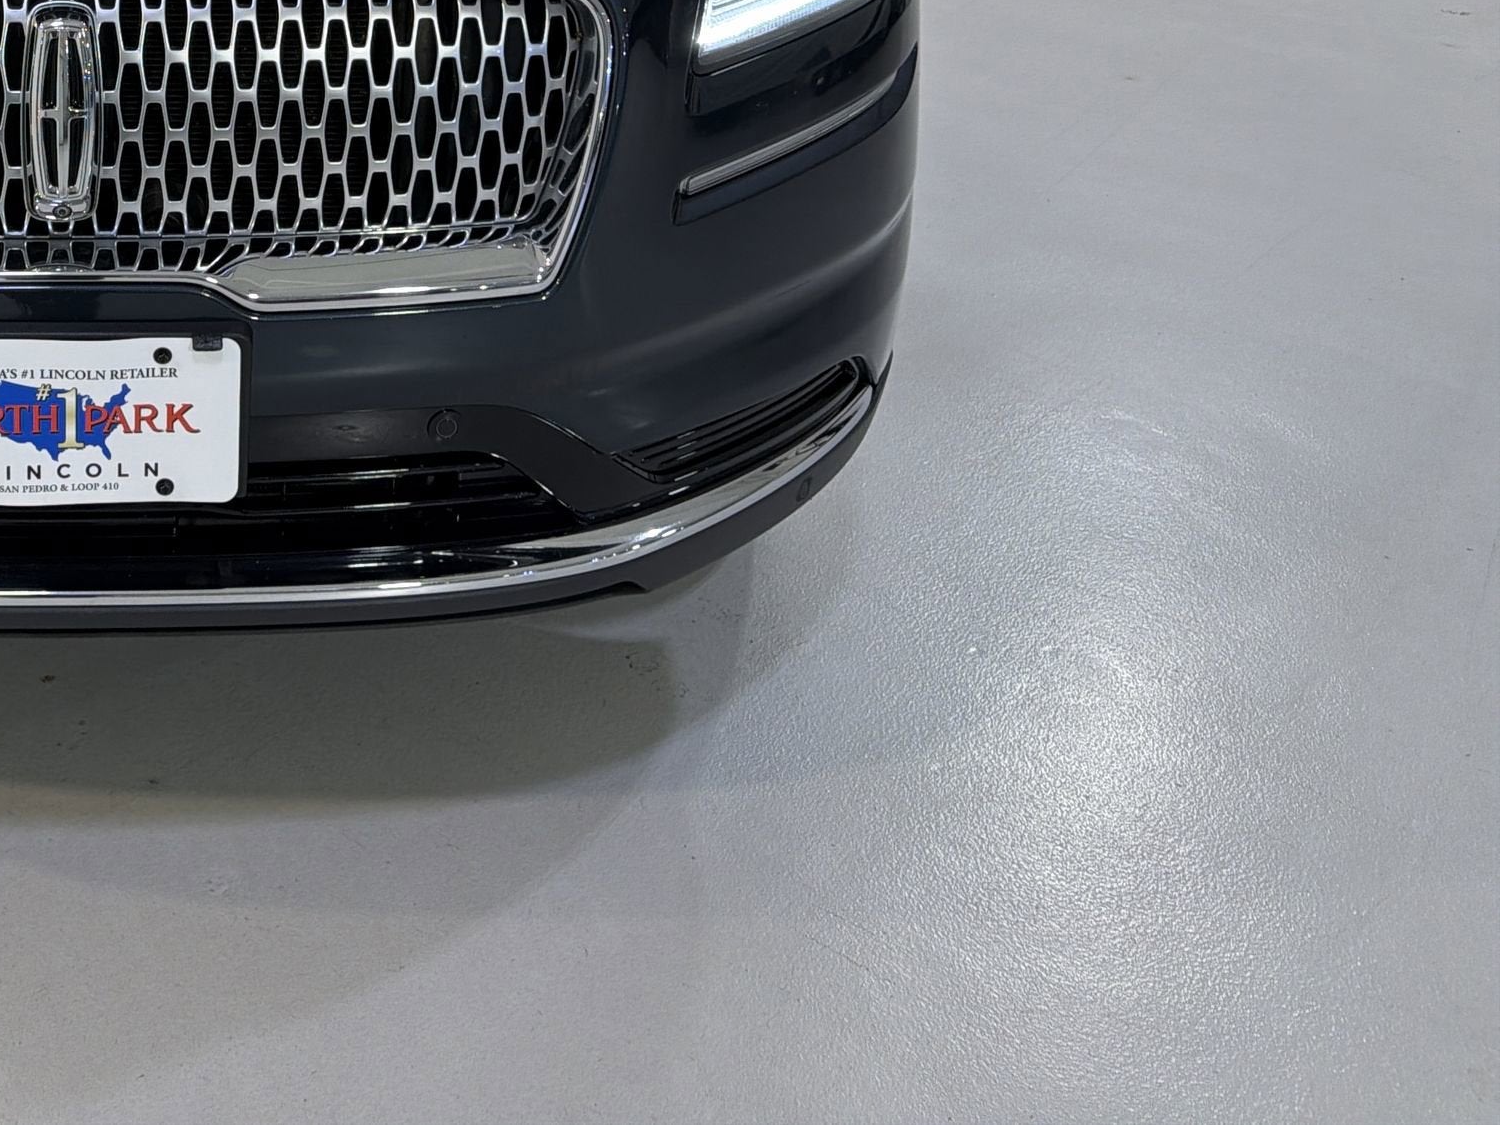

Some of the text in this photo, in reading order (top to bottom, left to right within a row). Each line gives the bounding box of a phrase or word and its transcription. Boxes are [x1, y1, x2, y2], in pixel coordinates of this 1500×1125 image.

[21, 369, 35, 380] #1
[39, 369, 106, 380] LINCOLN
[110, 367, 178, 380] RETAILER
[84, 403, 200, 434] PARK
[0, 482, 120, 493] SAN PEDRO & LOOP 410
